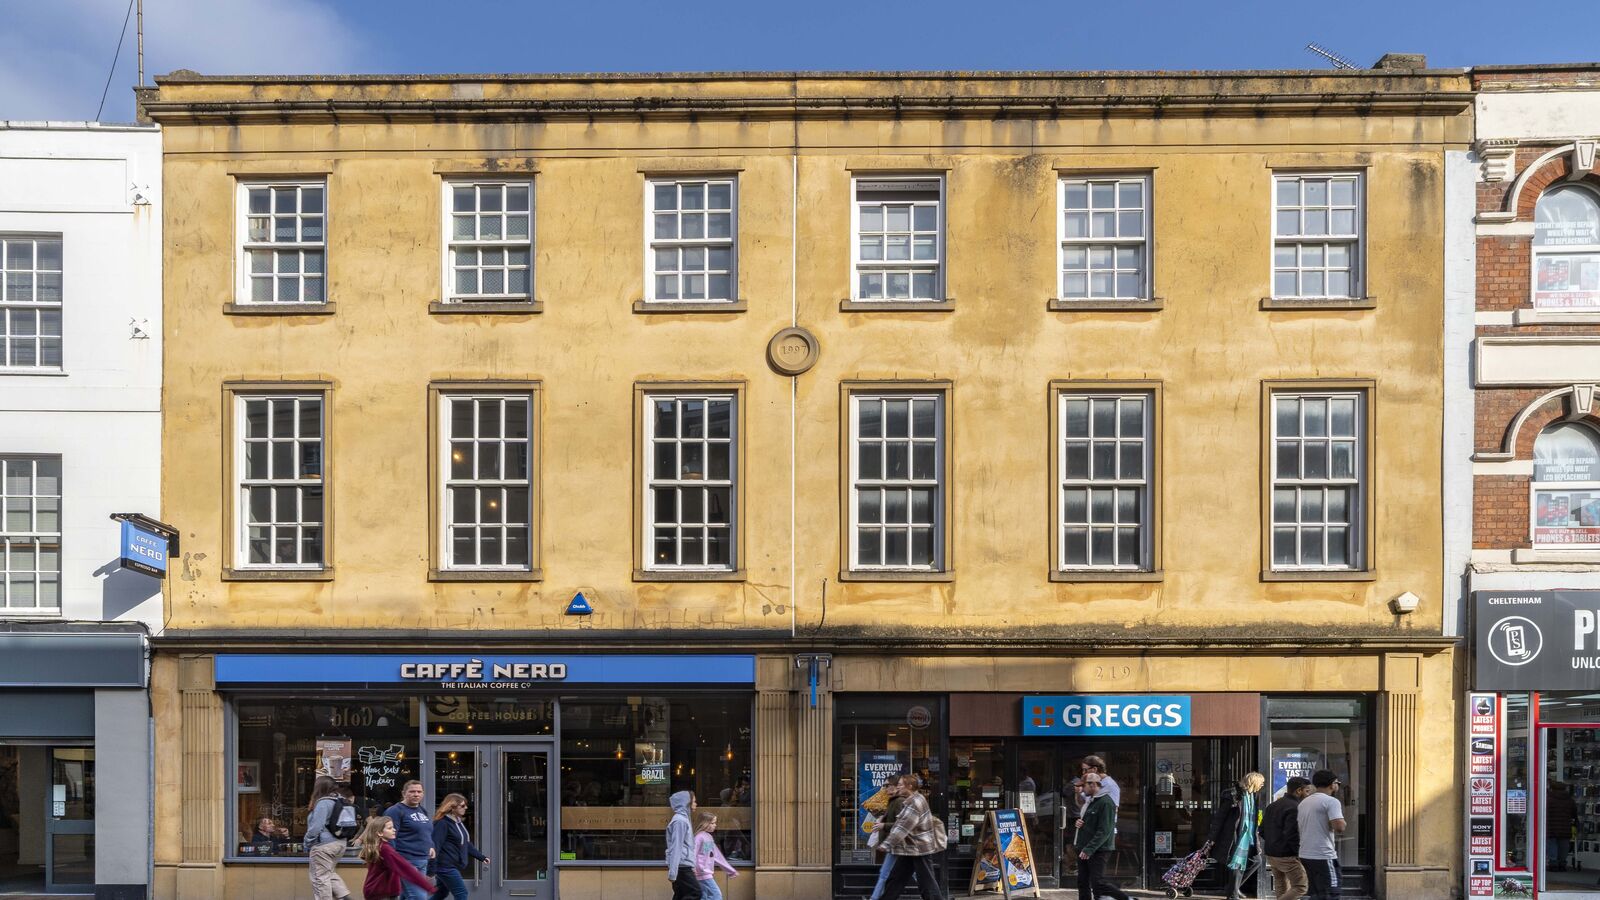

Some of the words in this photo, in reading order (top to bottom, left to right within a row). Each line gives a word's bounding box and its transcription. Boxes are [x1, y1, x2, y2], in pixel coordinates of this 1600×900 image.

[782, 345, 806, 354] 1997
[1537, 534, 1564, 543] PHONES
[1565, 534, 1570, 543] &
[1572, 534, 1600, 543] TABLETS
[130, 544, 162, 560] NERO
[1575, 610, 1600, 650] P
[400, 658, 482, 678] CAFFÈ
[494, 664, 566, 678] NERO
[450, 712, 490, 720] COFFEE
[495, 712, 532, 720] HOUSE
[1062, 704, 1182, 727] GREGGS
[642, 770, 665, 780] BRAZIL
